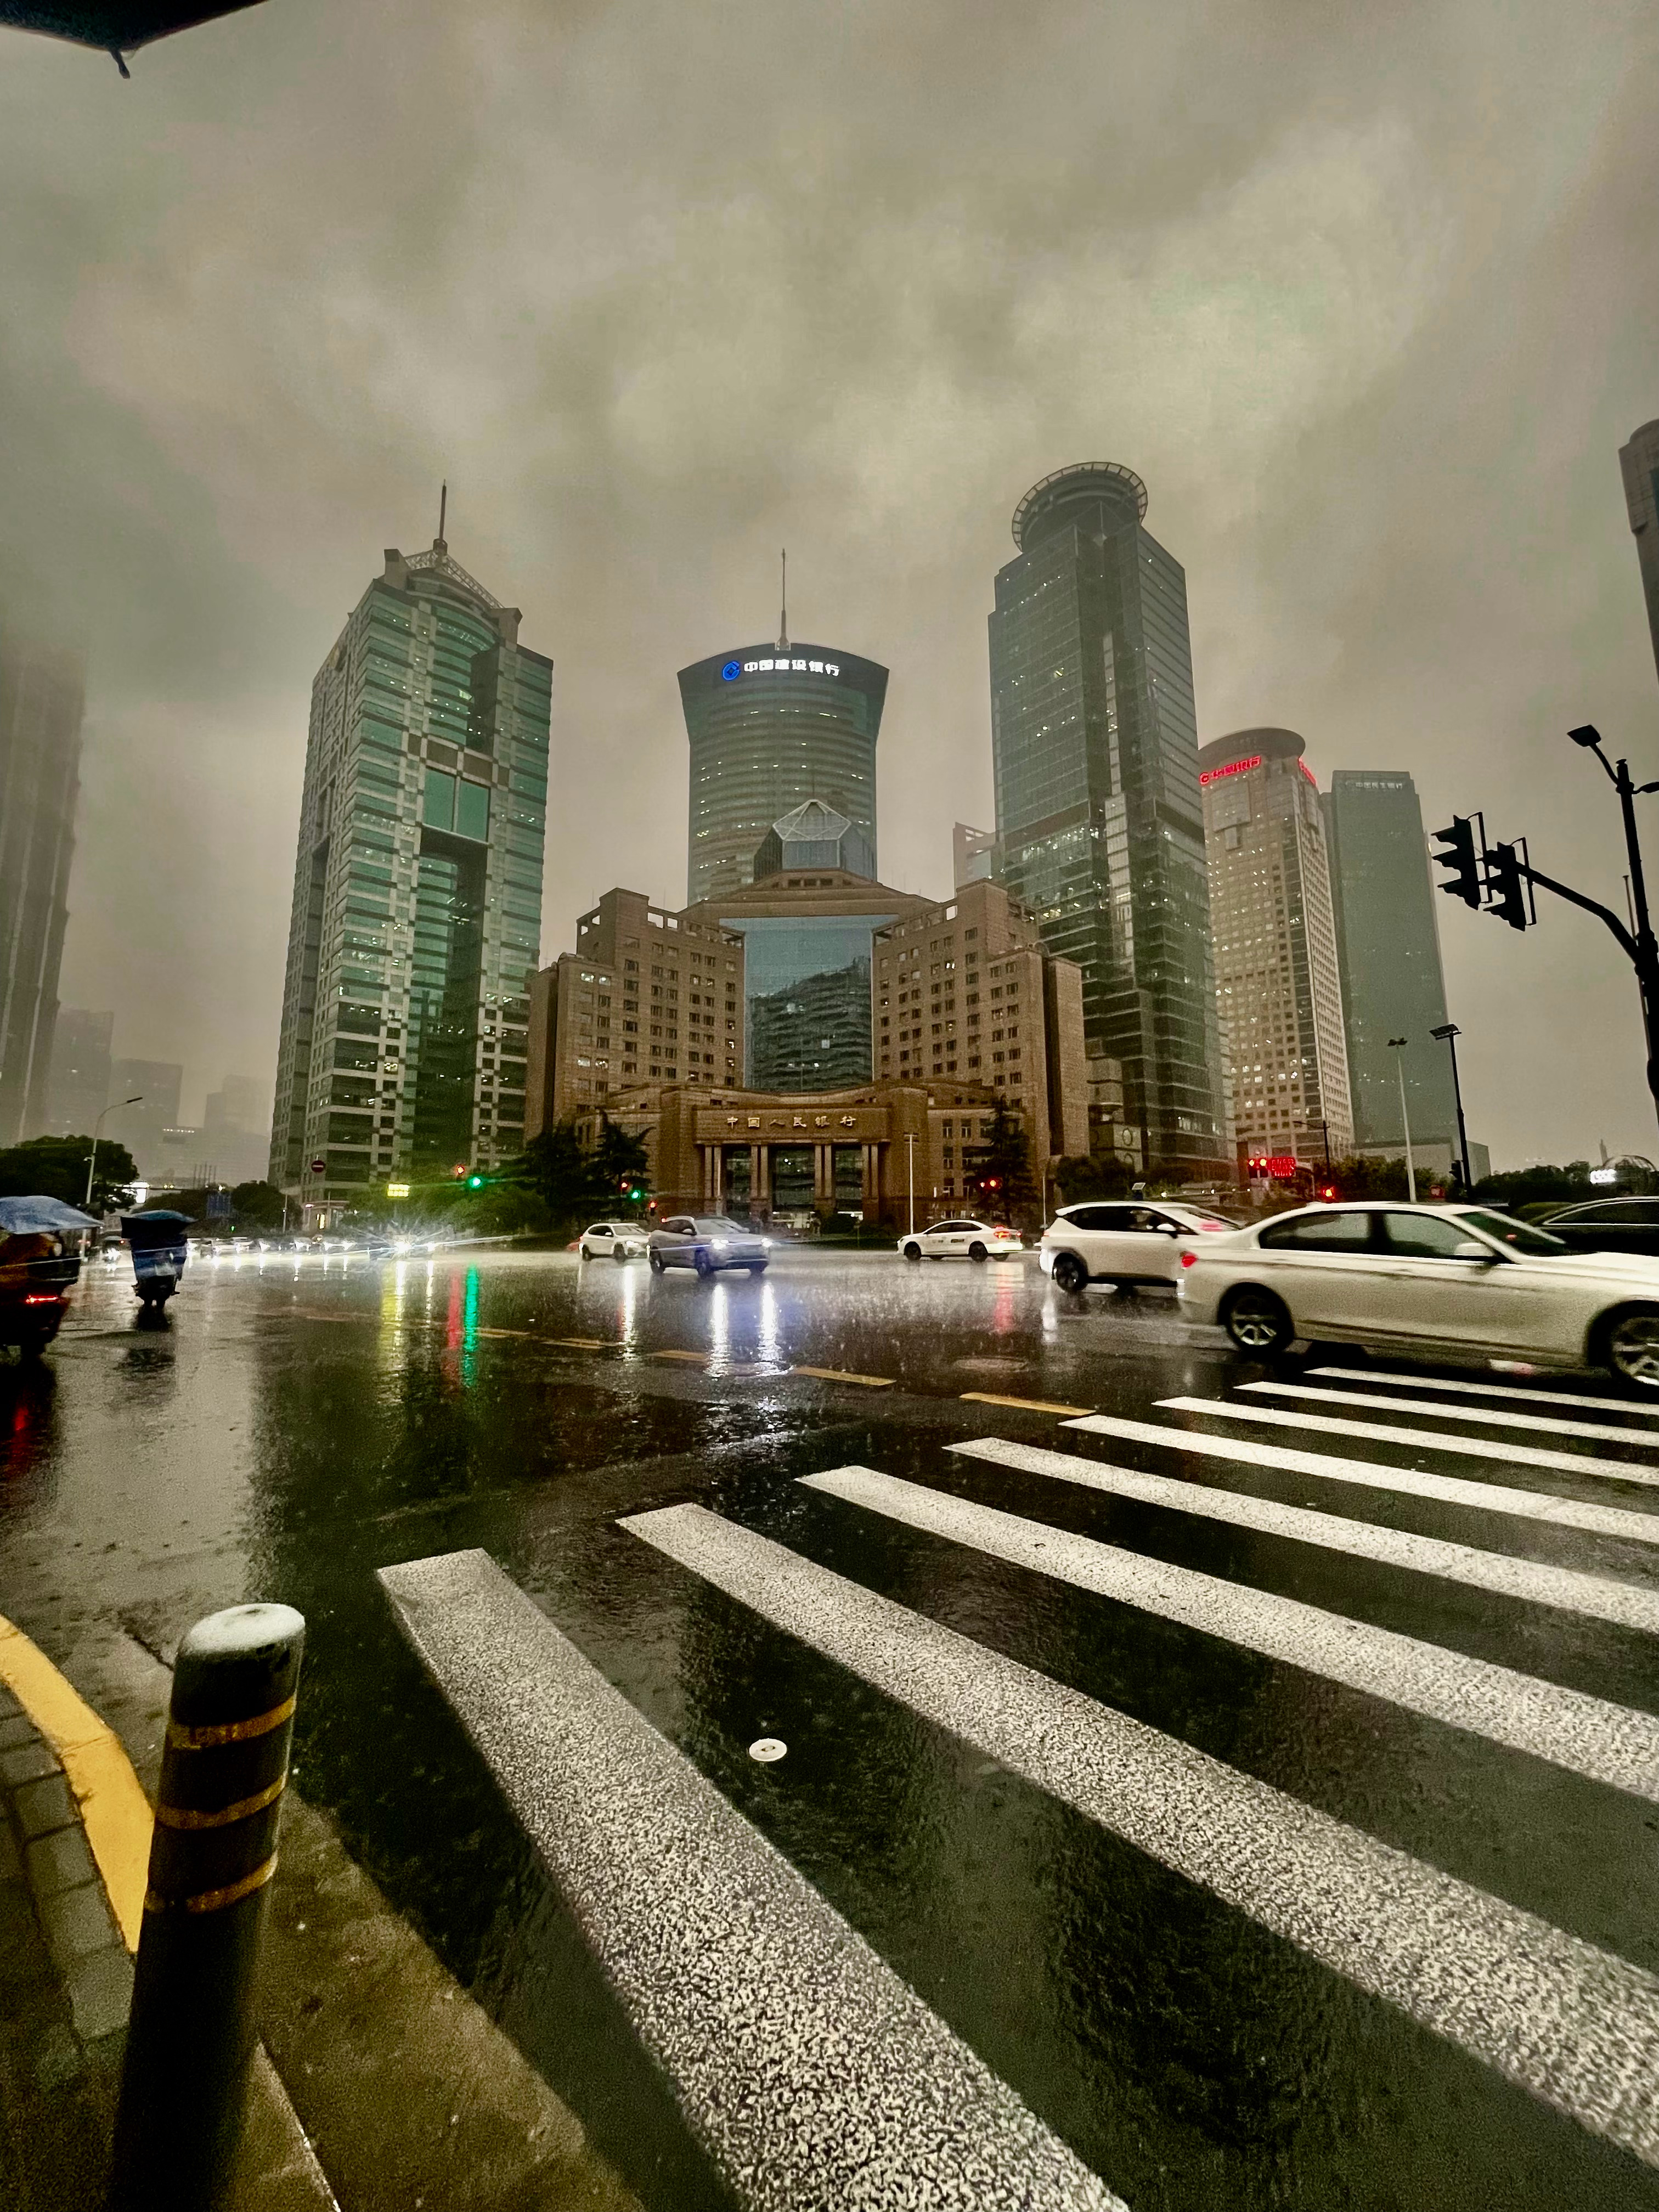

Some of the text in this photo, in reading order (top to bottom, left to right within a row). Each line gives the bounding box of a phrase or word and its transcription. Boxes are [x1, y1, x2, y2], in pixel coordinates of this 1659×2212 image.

[744, 659, 840, 676] 中国建设银行
[727, 1115, 856, 1130] 中国人民银行
